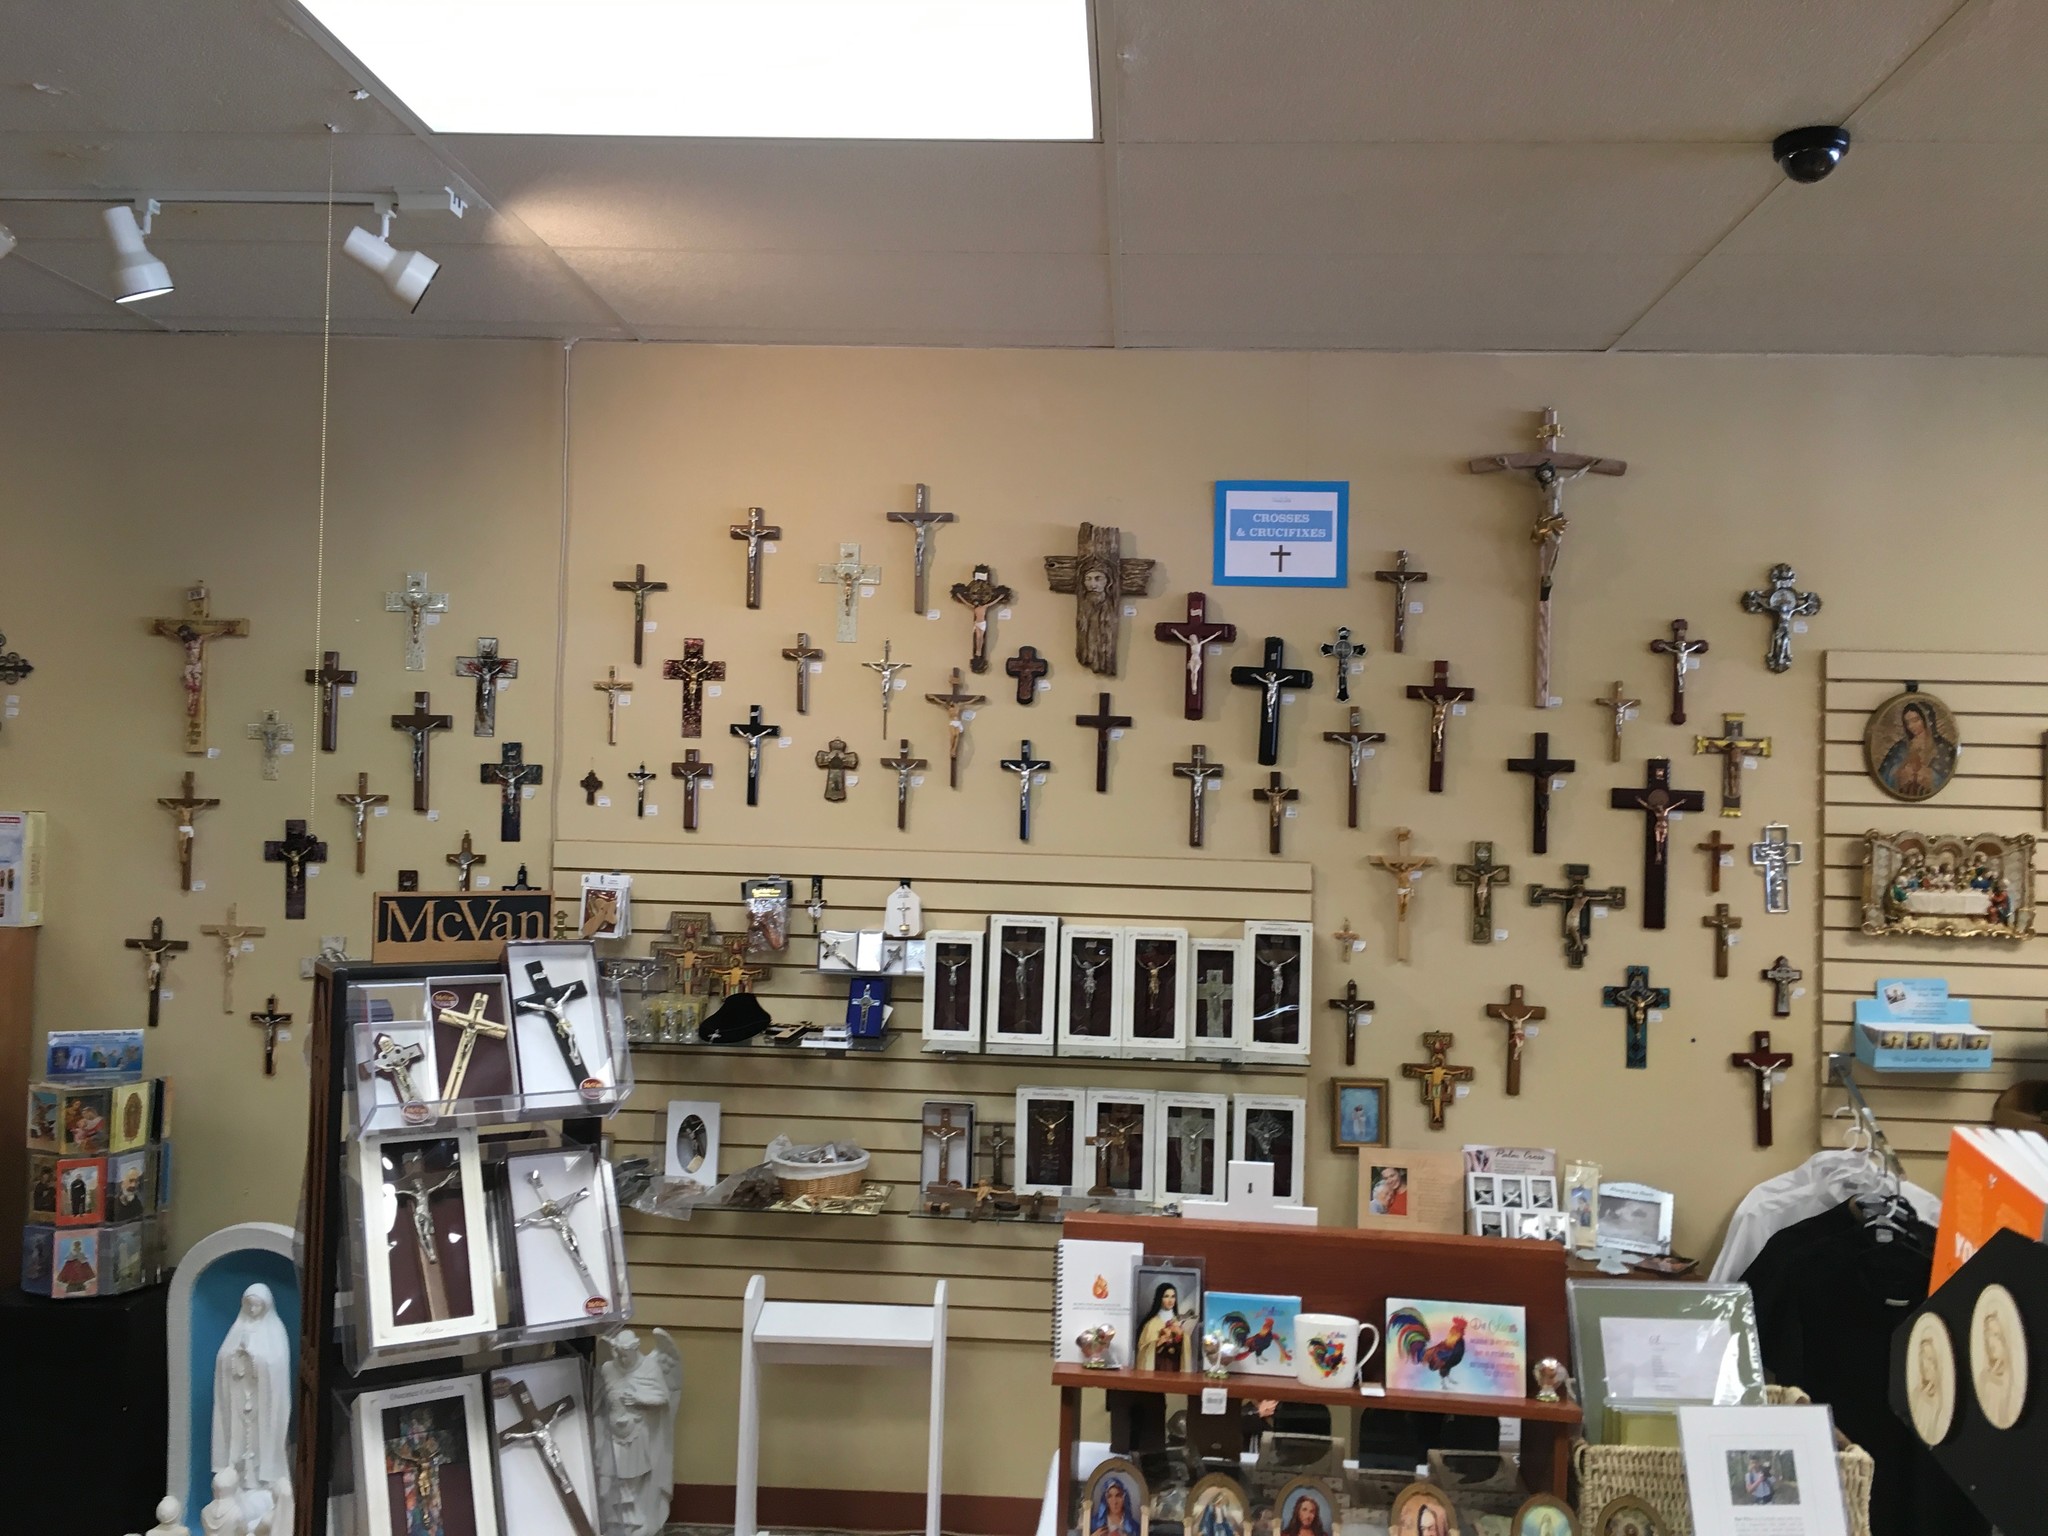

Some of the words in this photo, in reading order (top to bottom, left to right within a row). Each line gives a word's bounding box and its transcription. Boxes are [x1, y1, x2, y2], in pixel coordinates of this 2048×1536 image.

[1252, 513, 1310, 523] CROSSES
[1236, 528, 1246, 537] &
[1249, 528, 1326, 538] CRUCIFIXES
[383, 899, 550, 942] McVan
[1955, 1231, 1980, 1263] YO
